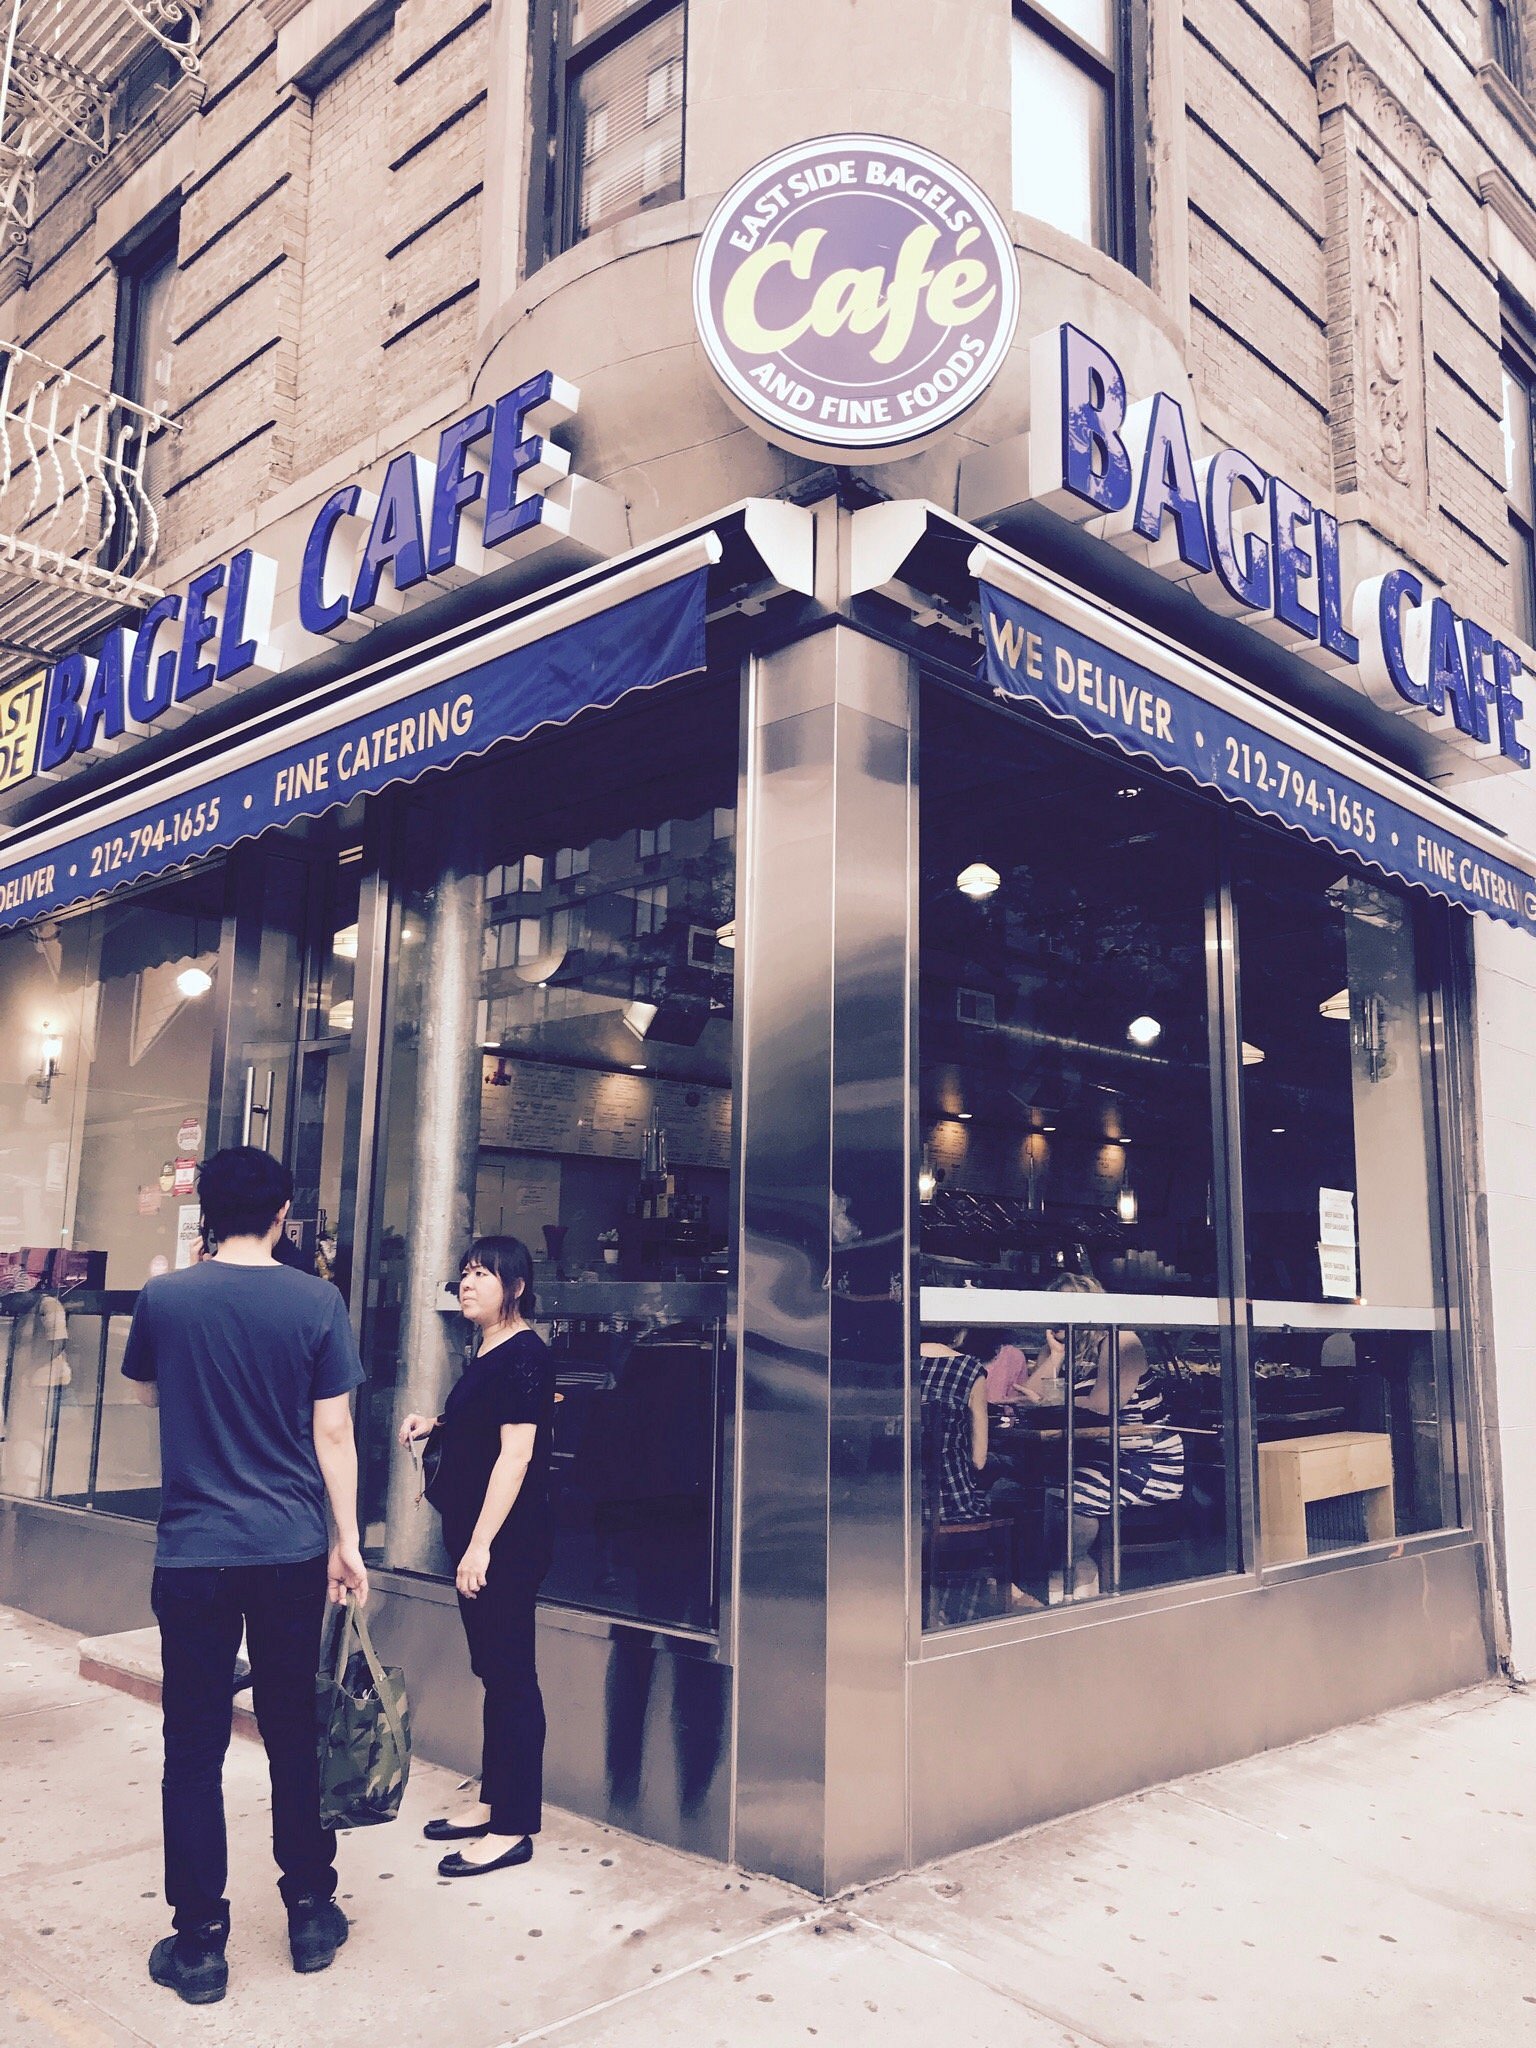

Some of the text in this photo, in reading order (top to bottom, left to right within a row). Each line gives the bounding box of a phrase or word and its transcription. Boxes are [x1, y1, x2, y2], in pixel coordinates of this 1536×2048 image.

[723, 224, 996, 364] Café
[729, 161, 973, 252] EAST SIDE BAGELS
[749, 333, 985, 424] AND FINE FOODS
[41, 370, 553, 771] BAGEL CAFE
[1061, 322, 1531, 768] BAGEL CAFE
[90, 797, 220, 877] 212-794-1655
[274, 752, 329, 807] FINE
[337, 694, 474, 781] CATERING
[989, 612, 1044, 680] WE
[1055, 646, 1175, 744] DELIVER
[1225, 736, 1376, 843] 212-794-1655
[1417, 835, 1456, 883] FINE
